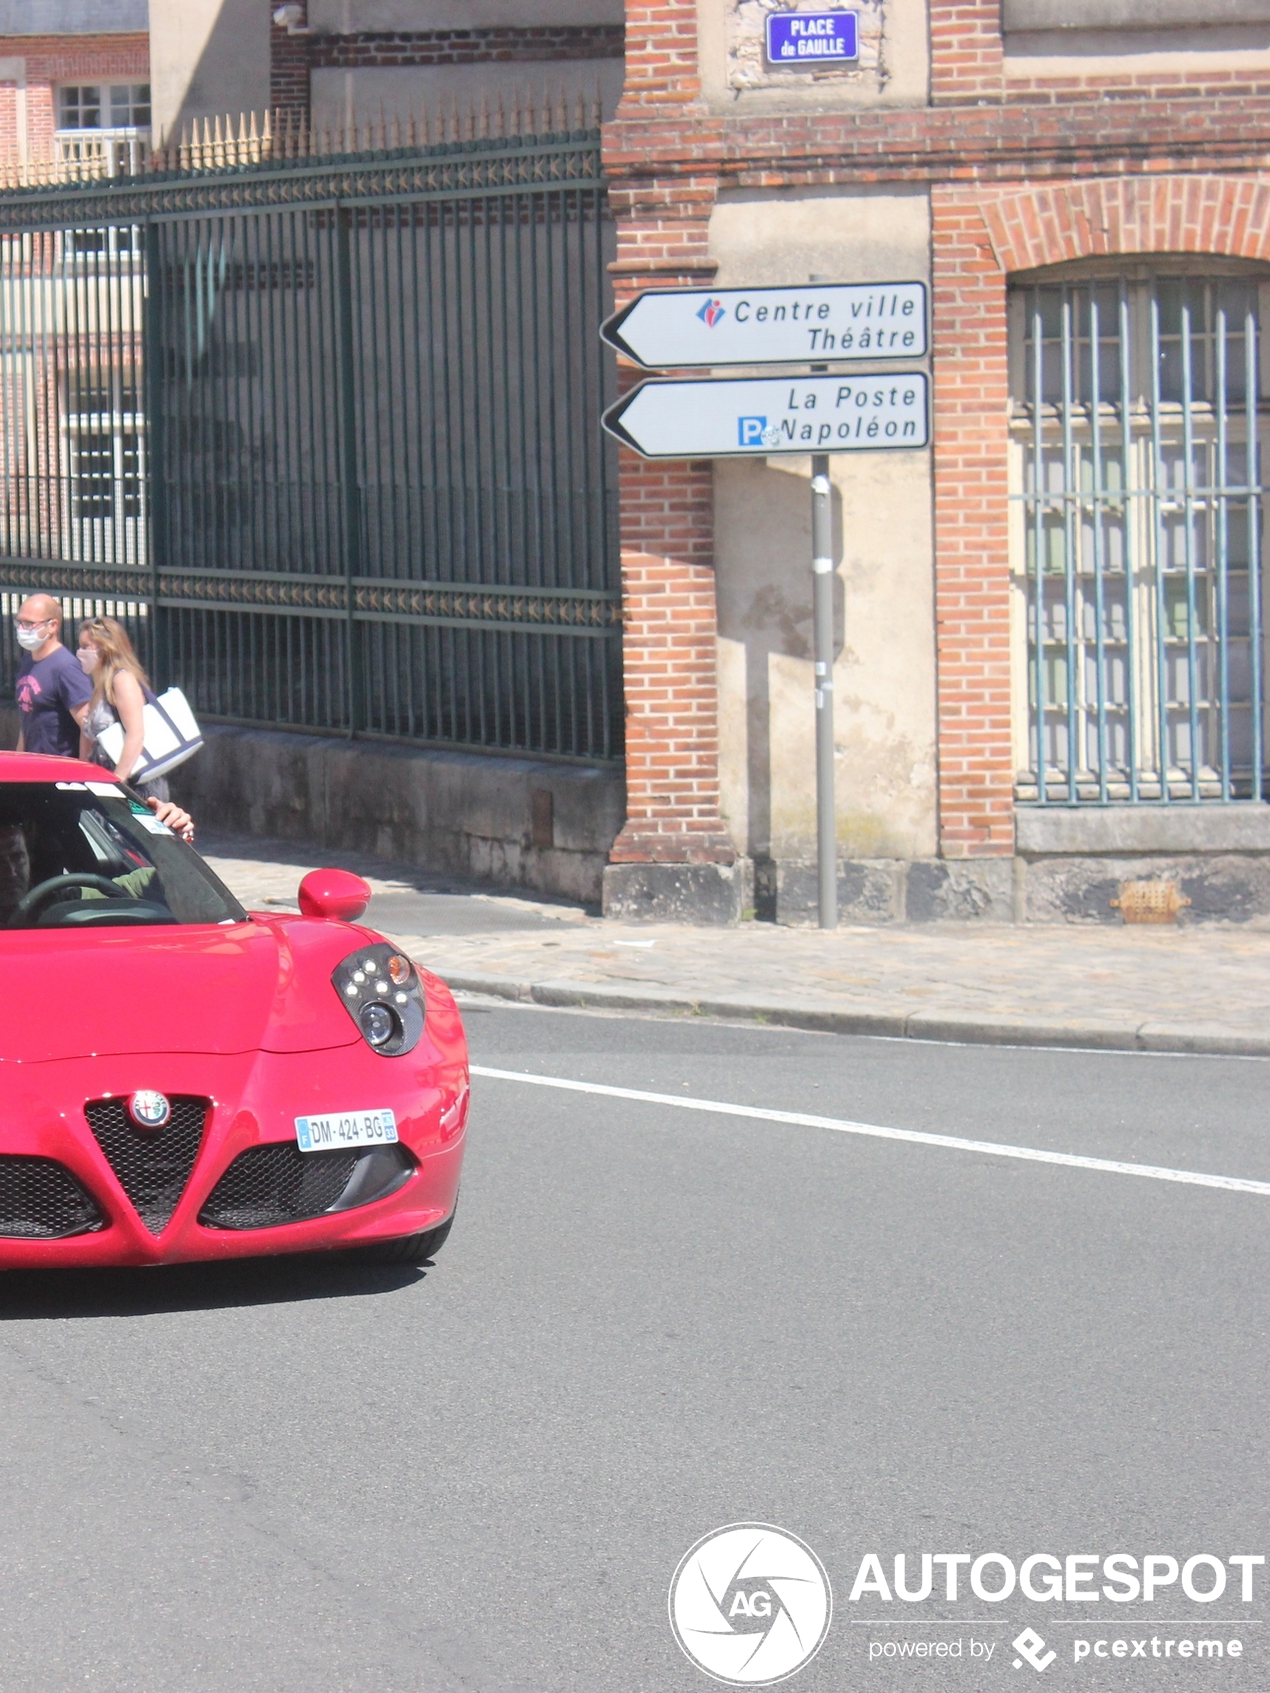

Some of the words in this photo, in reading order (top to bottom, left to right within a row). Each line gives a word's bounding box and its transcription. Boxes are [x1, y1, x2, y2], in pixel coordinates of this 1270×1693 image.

[791, 19, 835, 36] PLACE
[781, 40, 796, 56] de
[798, 38, 845, 55] GAULLE
[735, 301, 831, 323] Centre
[850, 295, 915, 318] ville
[808, 327, 915, 350] Théâtre
[788, 388, 817, 410] La
[835, 386, 916, 408] Poste
[780, 416, 916, 445] Napoléon
